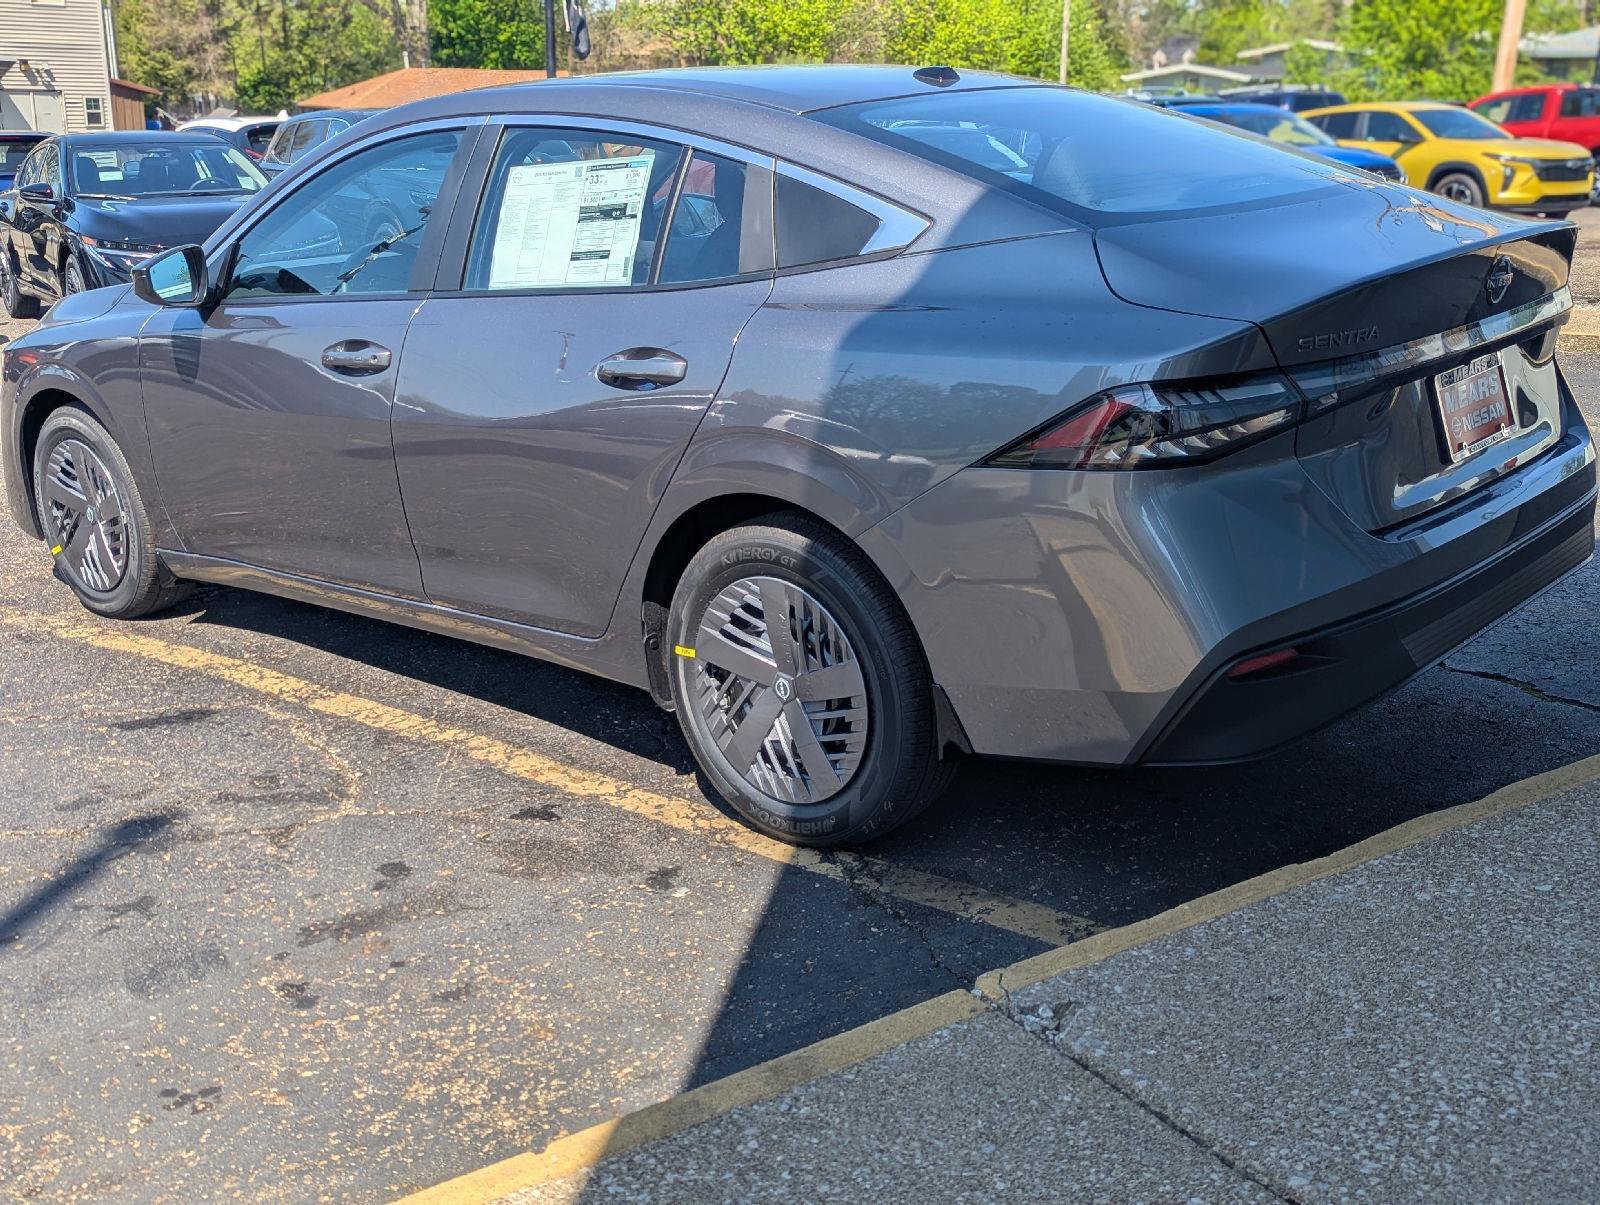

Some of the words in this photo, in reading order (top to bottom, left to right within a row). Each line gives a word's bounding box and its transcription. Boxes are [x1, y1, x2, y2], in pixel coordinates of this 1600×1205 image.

[590, 175, 599, 184] 33
[1298, 325, 1378, 352] SENTRA
[1454, 359, 1487, 382] MEARS
[1444, 373, 1499, 413] MEARS
[1463, 400, 1505, 432] NISSAN
[781, 555, 797, 567] GT
